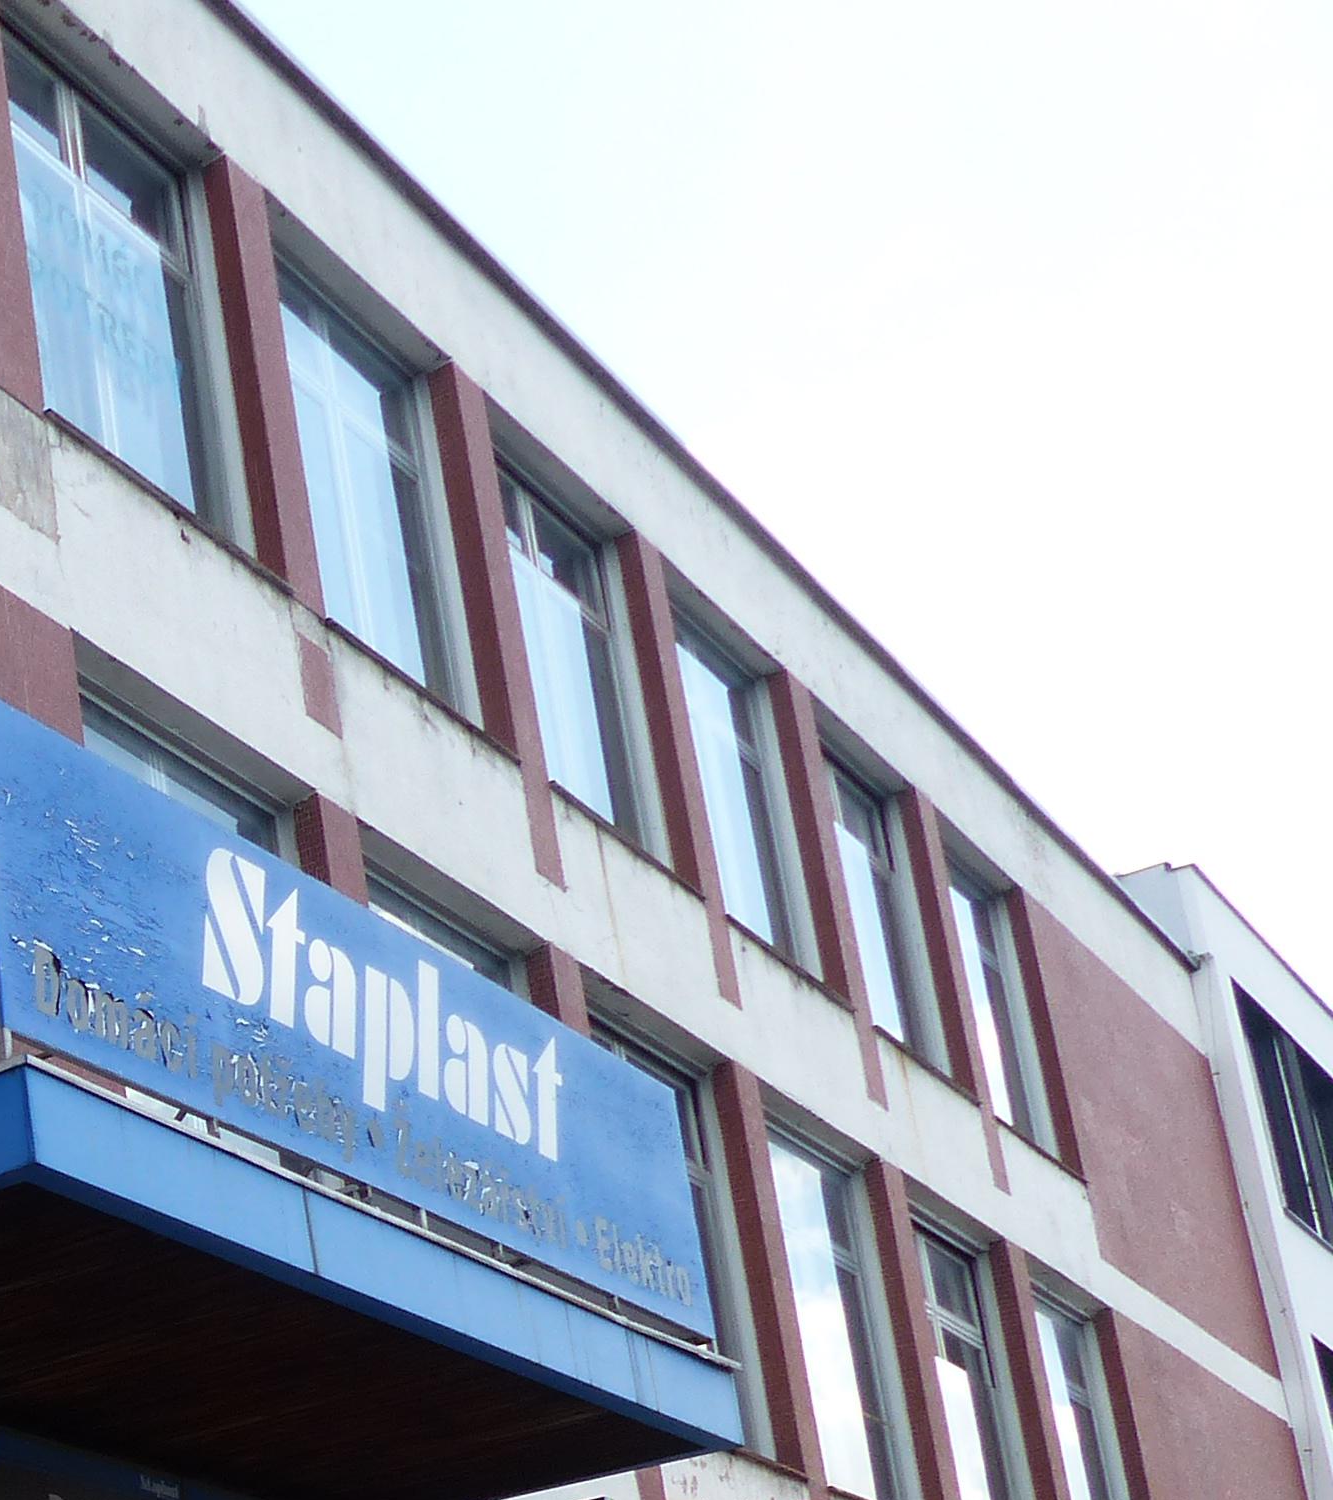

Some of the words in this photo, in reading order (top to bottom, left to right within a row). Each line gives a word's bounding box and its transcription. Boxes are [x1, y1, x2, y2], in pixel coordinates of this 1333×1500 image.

[33, 940, 199, 1079] Domácí
[594, 1215, 692, 1307] Elektro
[201, 847, 564, 1162] Staplast
